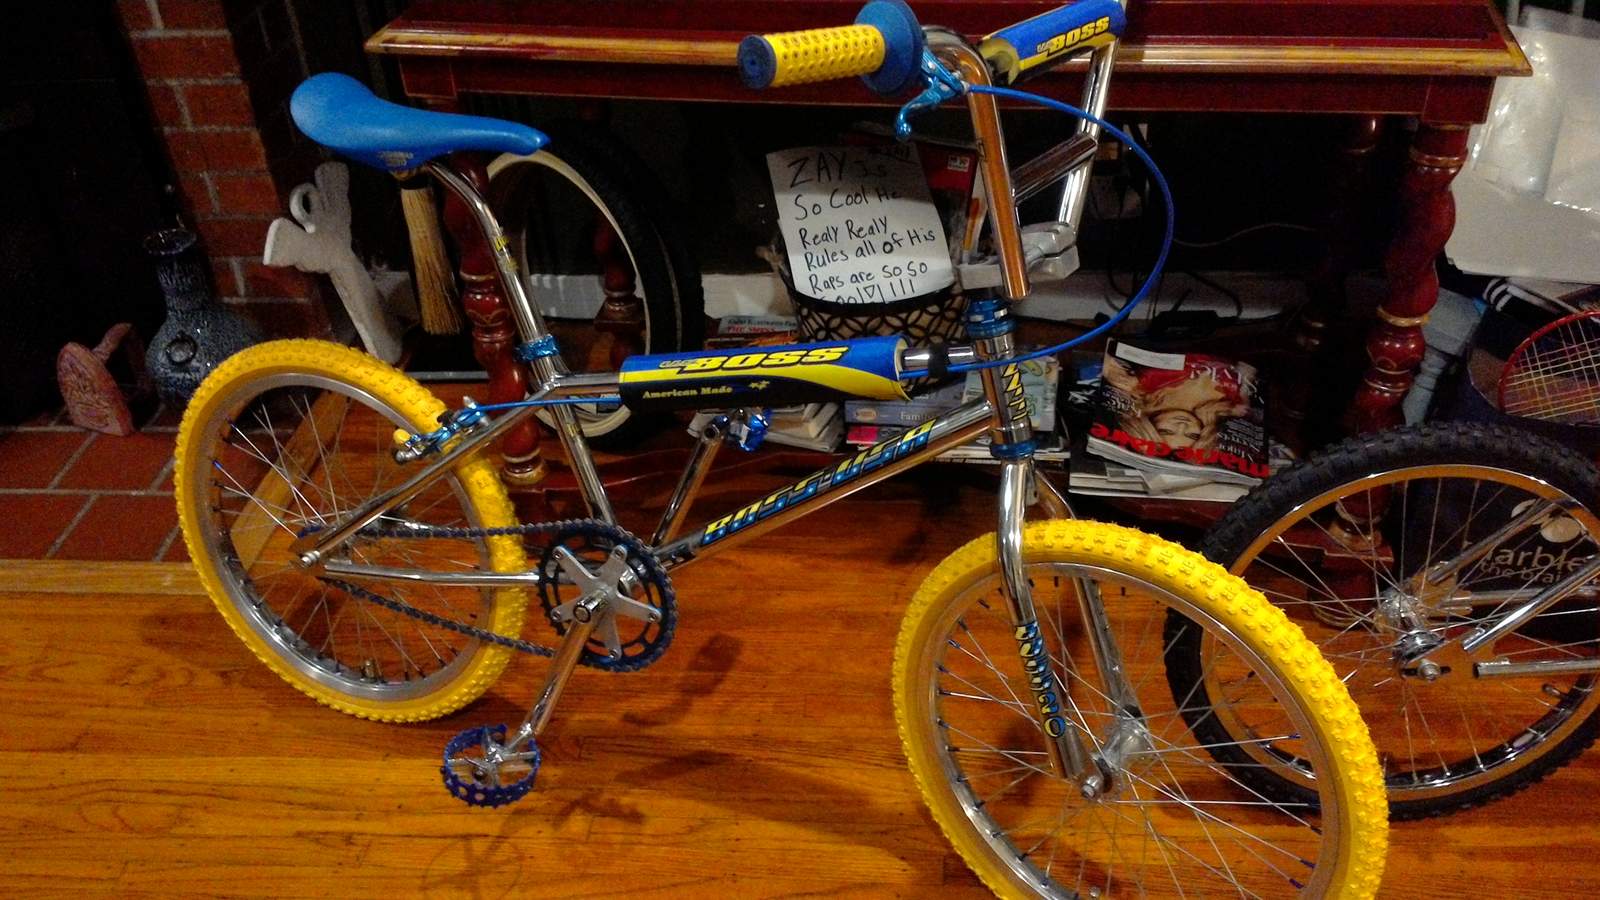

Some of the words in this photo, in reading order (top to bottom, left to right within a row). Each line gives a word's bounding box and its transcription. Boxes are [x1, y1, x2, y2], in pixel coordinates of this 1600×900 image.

[1049, 16, 1110, 53] BOSS
[787, 151, 848, 188] ZAY
[794, 194, 822, 221] So
[830, 185, 869, 208] Cool
[799, 226, 839, 249] Realy
[845, 216, 888, 240] Realy
[804, 249, 849, 271] Rules
[855, 240, 877, 258] all
[882, 232, 904, 254] of
[907, 228, 936, 246] His
[809, 273, 845, 294] Raps
[850, 271, 875, 284] are
[681, 347, 849, 373] BOSS
[642, 388, 699, 400] American
[701, 386, 733, 397] Made
